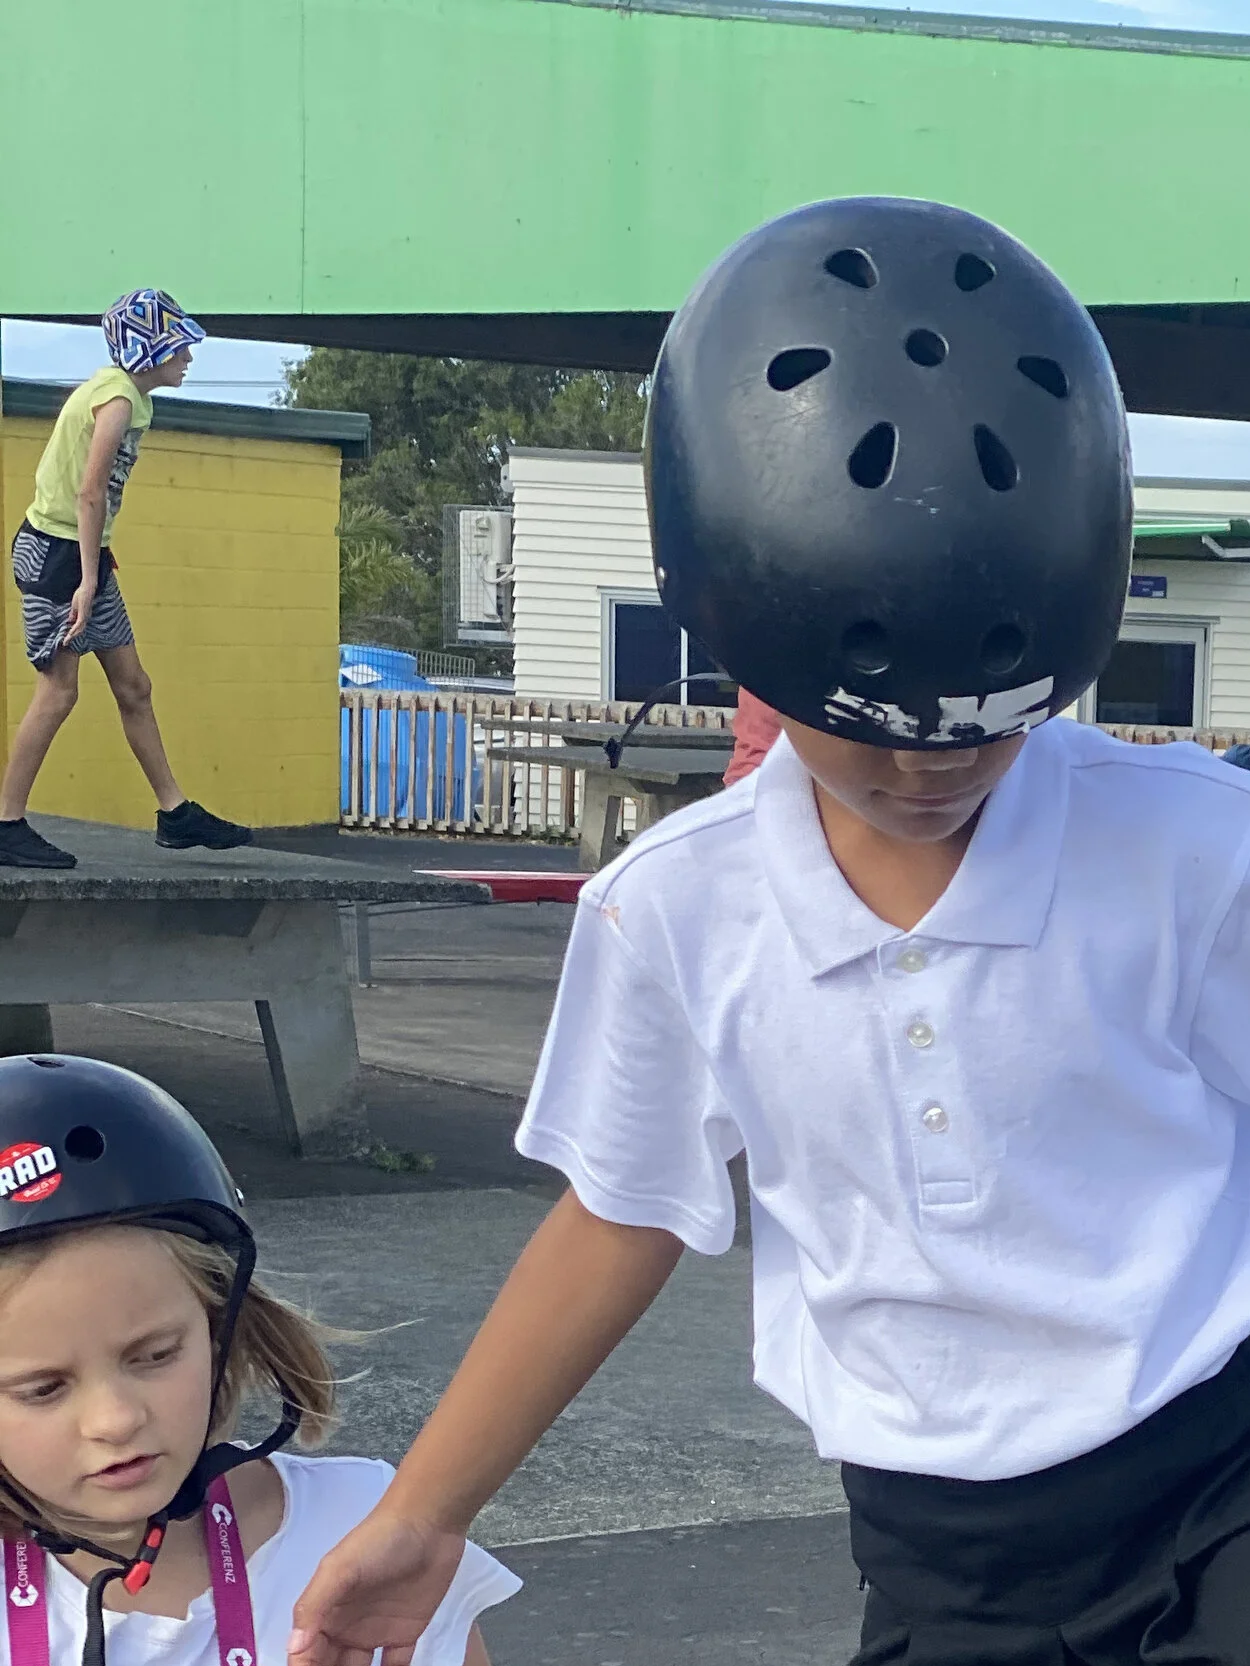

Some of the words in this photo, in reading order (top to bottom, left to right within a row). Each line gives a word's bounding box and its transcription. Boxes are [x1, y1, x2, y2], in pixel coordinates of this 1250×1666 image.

[0, 1146, 57, 1197] RAD
[16, 1541, 29, 1588] CONFERE
[218, 1522, 236, 1584] CONFERENZ
